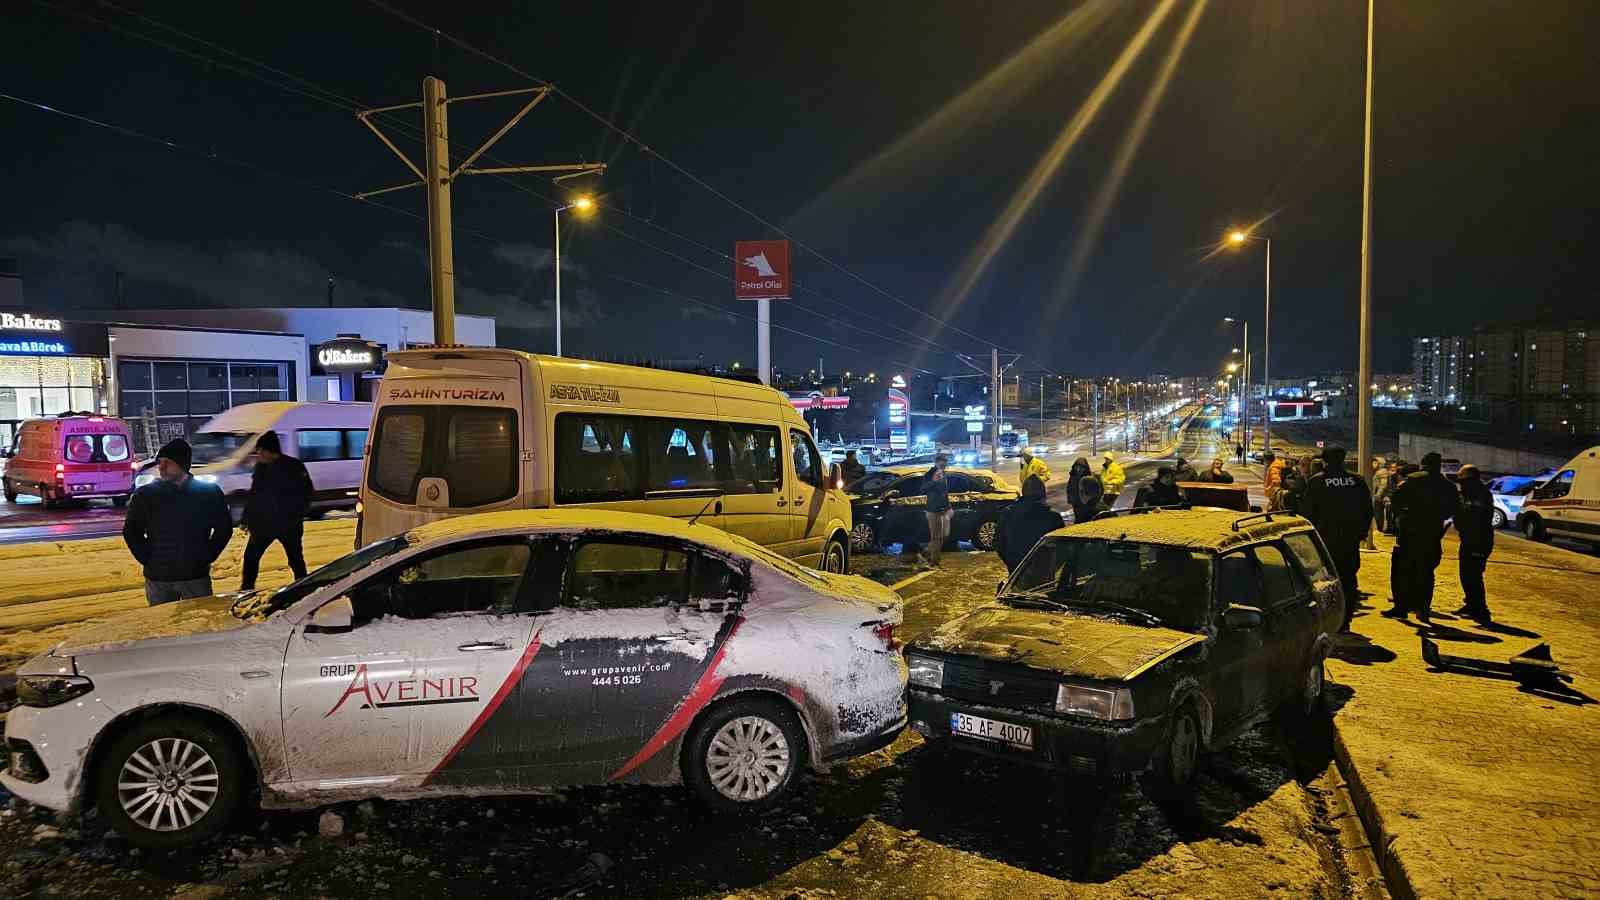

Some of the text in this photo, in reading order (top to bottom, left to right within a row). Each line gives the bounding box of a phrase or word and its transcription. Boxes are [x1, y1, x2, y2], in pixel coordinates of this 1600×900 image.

[320, 664, 356, 678] GRUP
[592, 675, 641, 686] 444 5 026
[959, 714, 973, 732] 35
[979, 720, 993, 737] AF
[999, 723, 1030, 744] 4007
